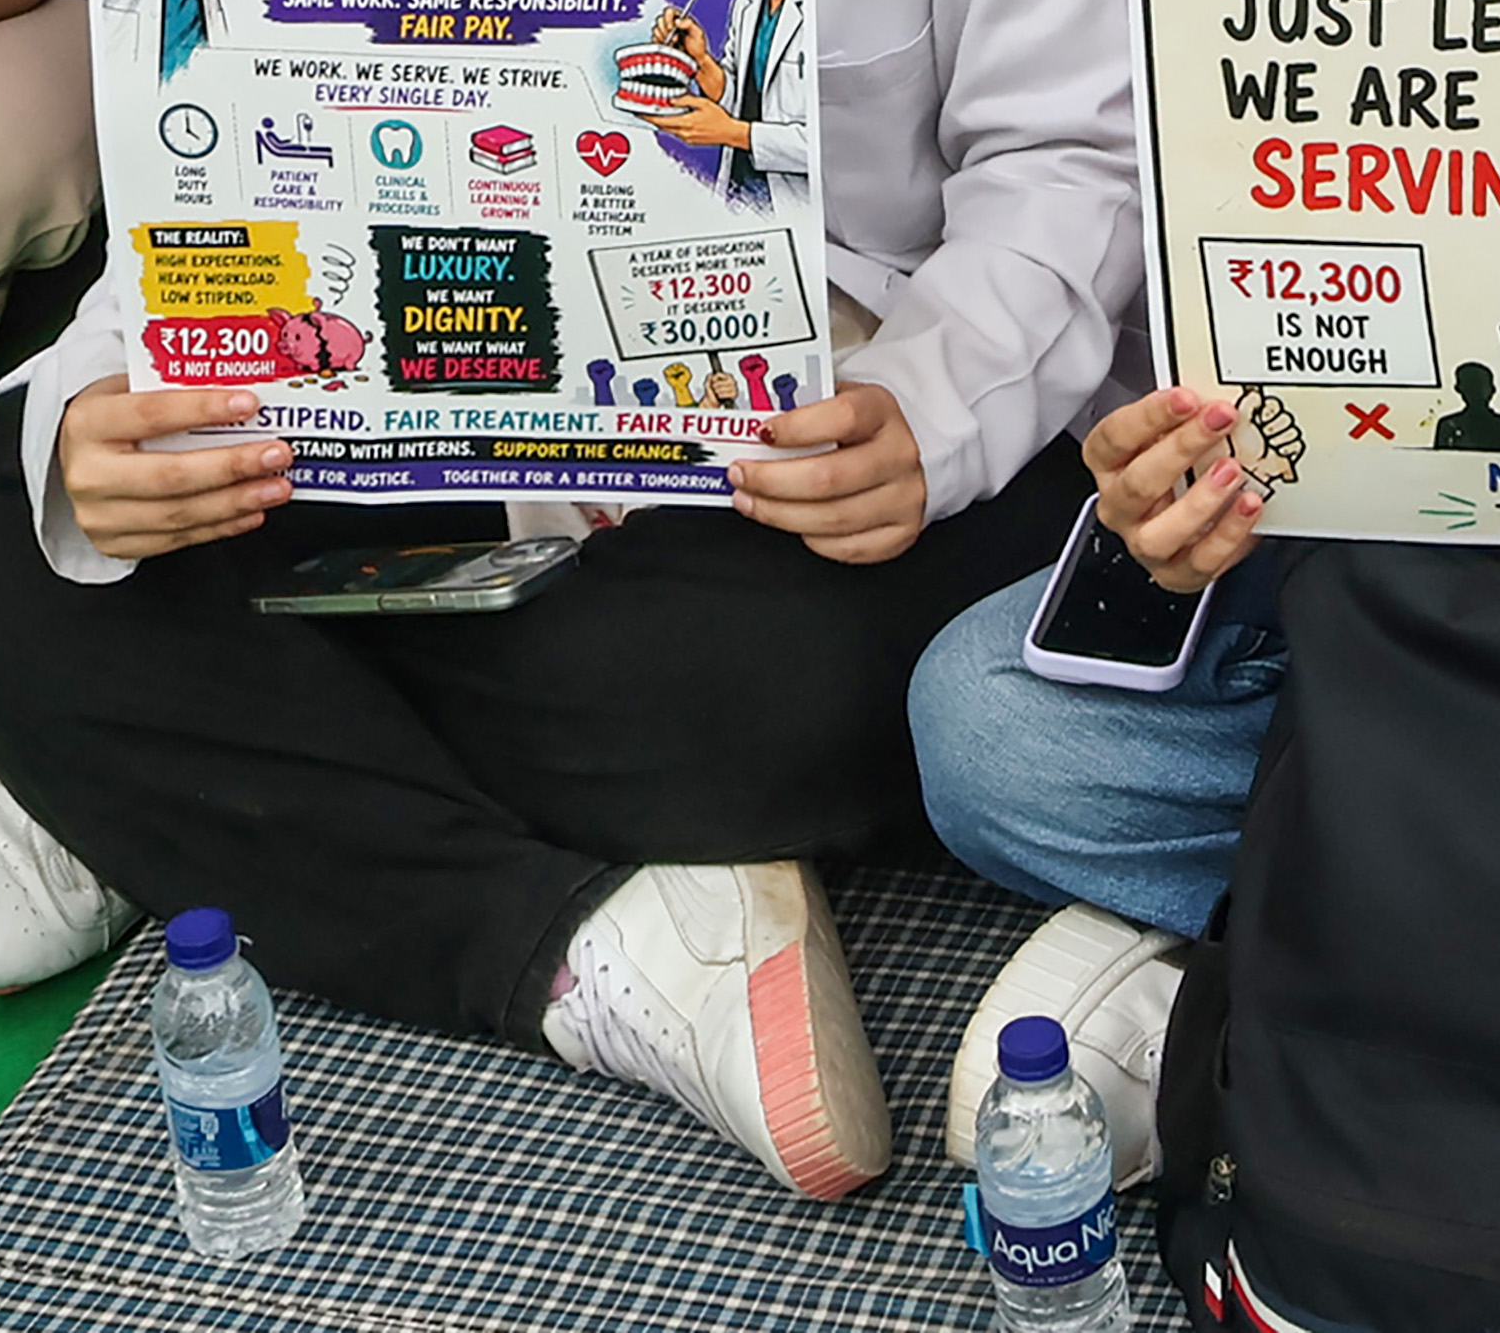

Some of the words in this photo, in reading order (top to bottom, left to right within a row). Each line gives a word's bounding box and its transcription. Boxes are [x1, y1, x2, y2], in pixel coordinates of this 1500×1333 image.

[1220, 59, 1320, 125] WE
[1349, 69, 1481, 130] ARE
[404, 304, 528, 335] DIGNITY.
[453, 410, 604, 433] TREATMENT.
[493, 442, 565, 459] SUPPORT
[570, 442, 608, 459] THE
[612, 444, 688, 461] CHANGE.
[993, 1230, 1078, 1273] Aqua
